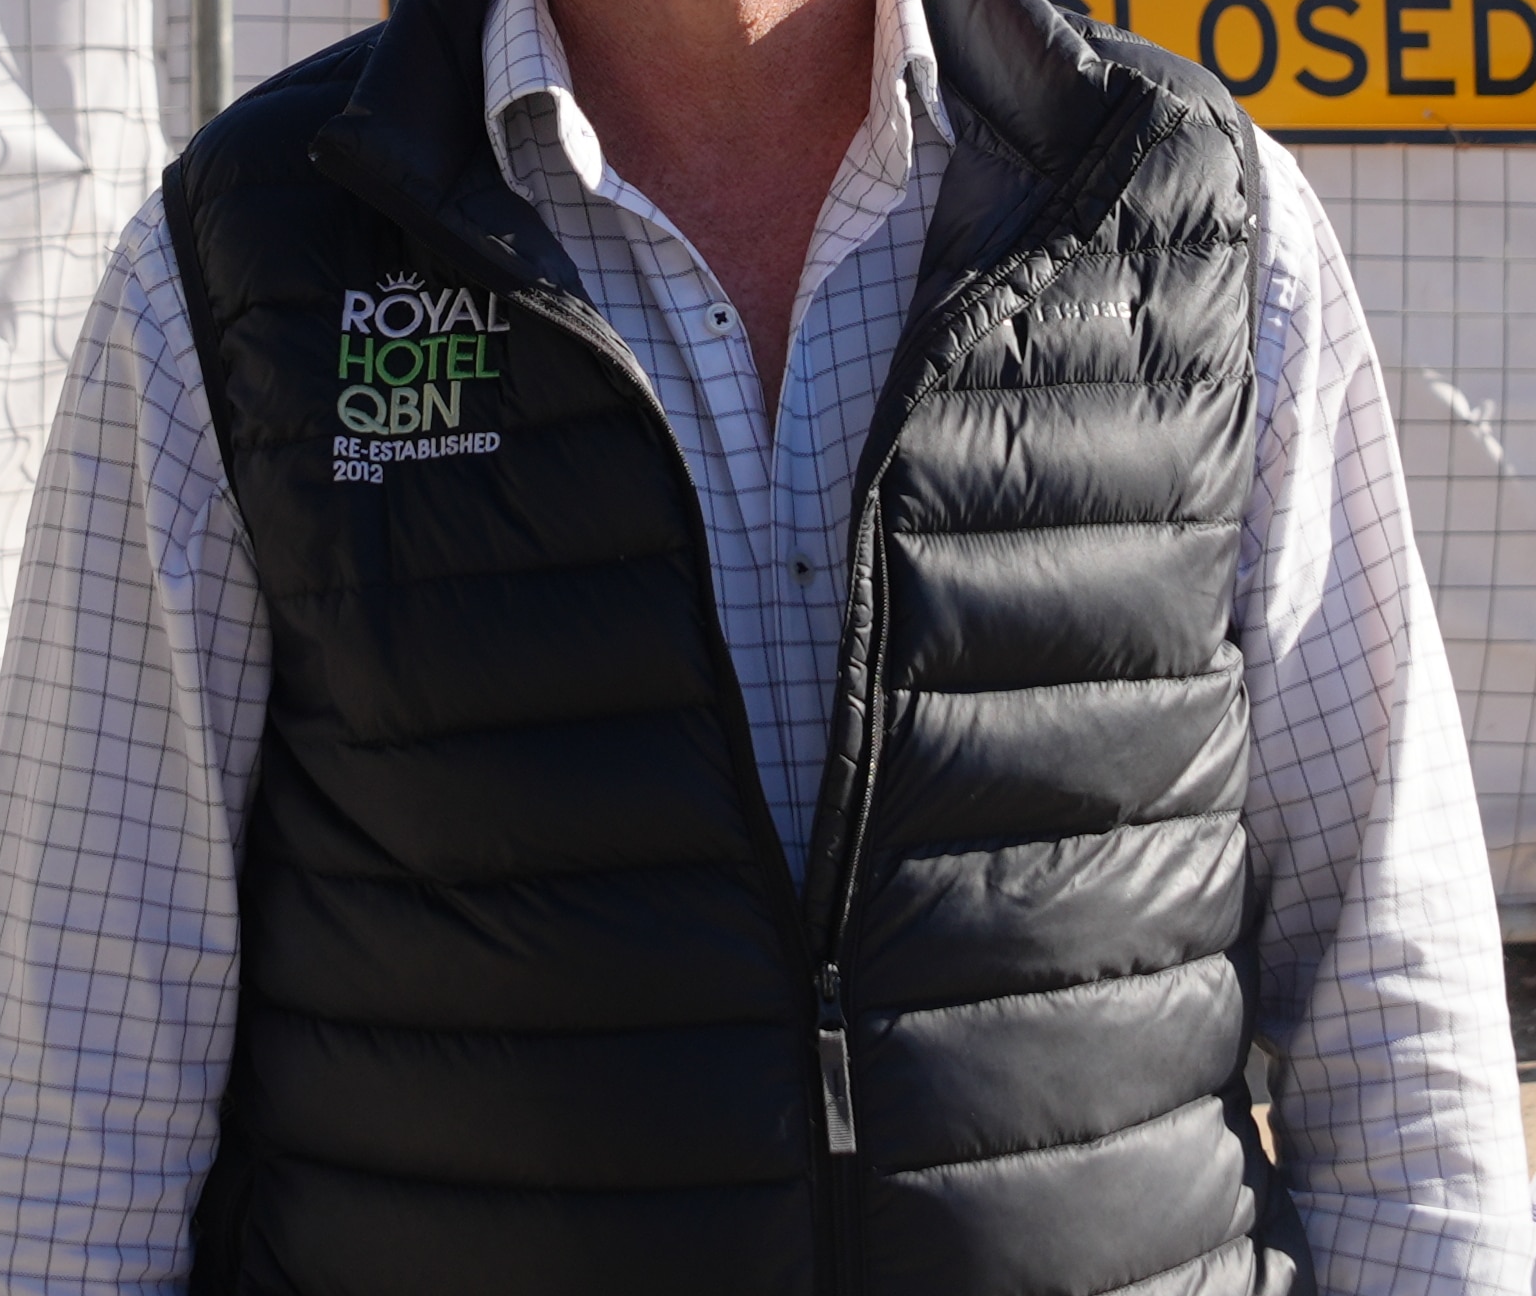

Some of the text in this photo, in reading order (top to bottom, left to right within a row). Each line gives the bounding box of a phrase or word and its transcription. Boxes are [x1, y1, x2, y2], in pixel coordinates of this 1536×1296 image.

[341, 287, 511, 339] ROYAL
[338, 334, 501, 386] HOTEL
[337, 380, 462, 436] QBN
[333, 431, 502, 462] RE-ESTABLISHED
[333, 460, 384, 484] 2012
